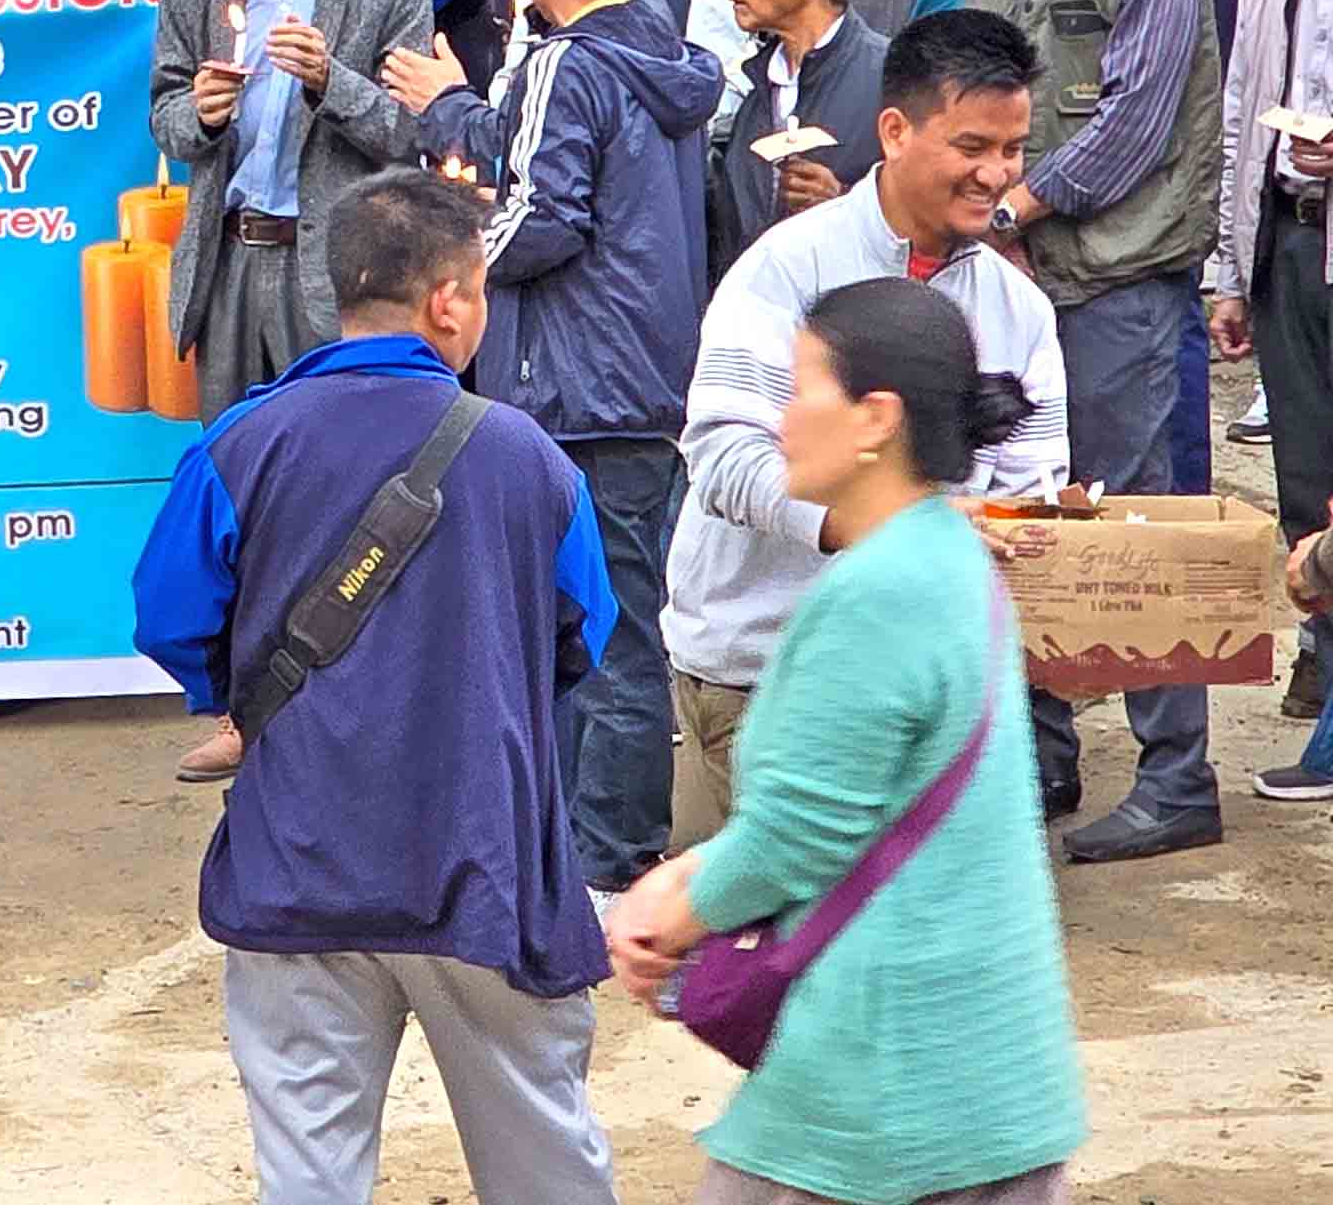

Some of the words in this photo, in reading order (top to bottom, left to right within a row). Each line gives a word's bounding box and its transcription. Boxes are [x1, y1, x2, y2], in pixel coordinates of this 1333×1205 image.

[53, 94, 97, 129] of
[8, 513, 73, 545] pm
[337, 546, 385, 602] Nikon
